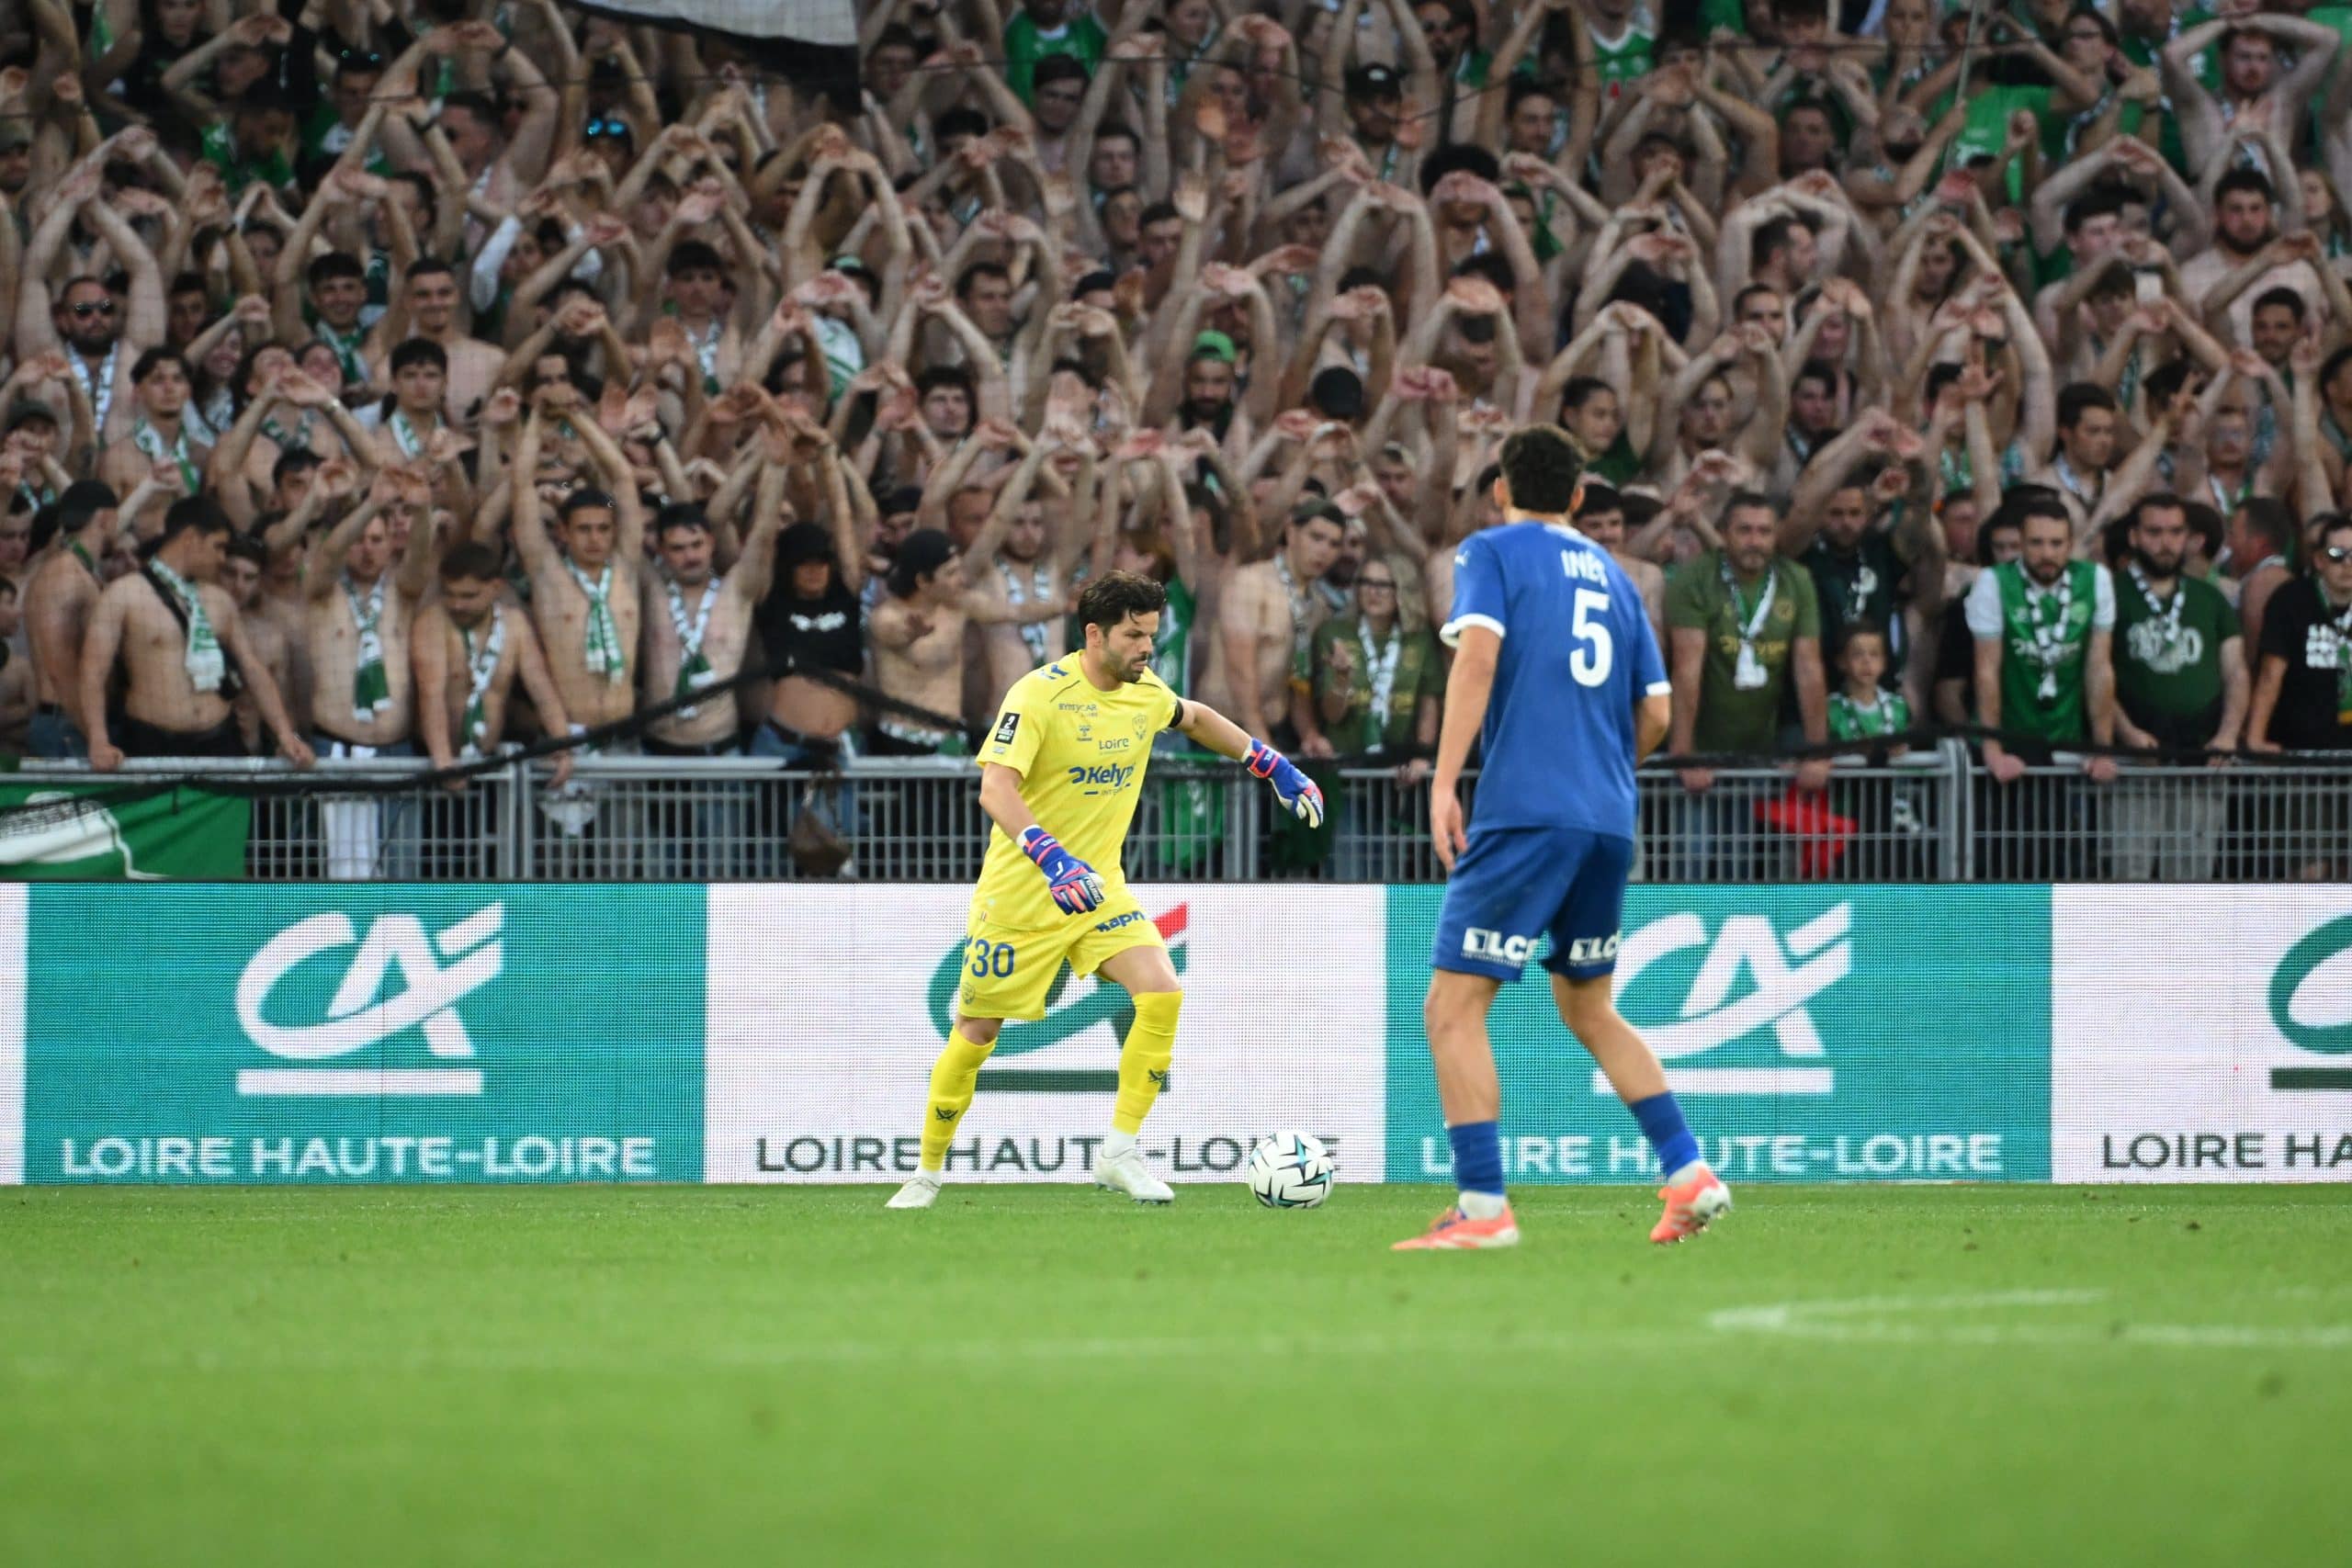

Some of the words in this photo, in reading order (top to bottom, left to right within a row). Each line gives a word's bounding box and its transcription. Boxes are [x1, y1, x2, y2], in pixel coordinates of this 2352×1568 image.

[1569, 588, 1613, 687] 5
[971, 939, 1015, 978] 30
[62, 1136, 235, 1176] LOIRE
[252, 1136, 657, 1176] HAUTE-LOIRE
[756, 1136, 922, 1172] LOIRE
[945, 1135, 1340, 1172] HAUT-LO
[1421, 1135, 1591, 1175] LIRE
[1610, 1134, 2004, 1174] HUTE-LOIRE
[2103, 1134, 2265, 1168] LOIRE
